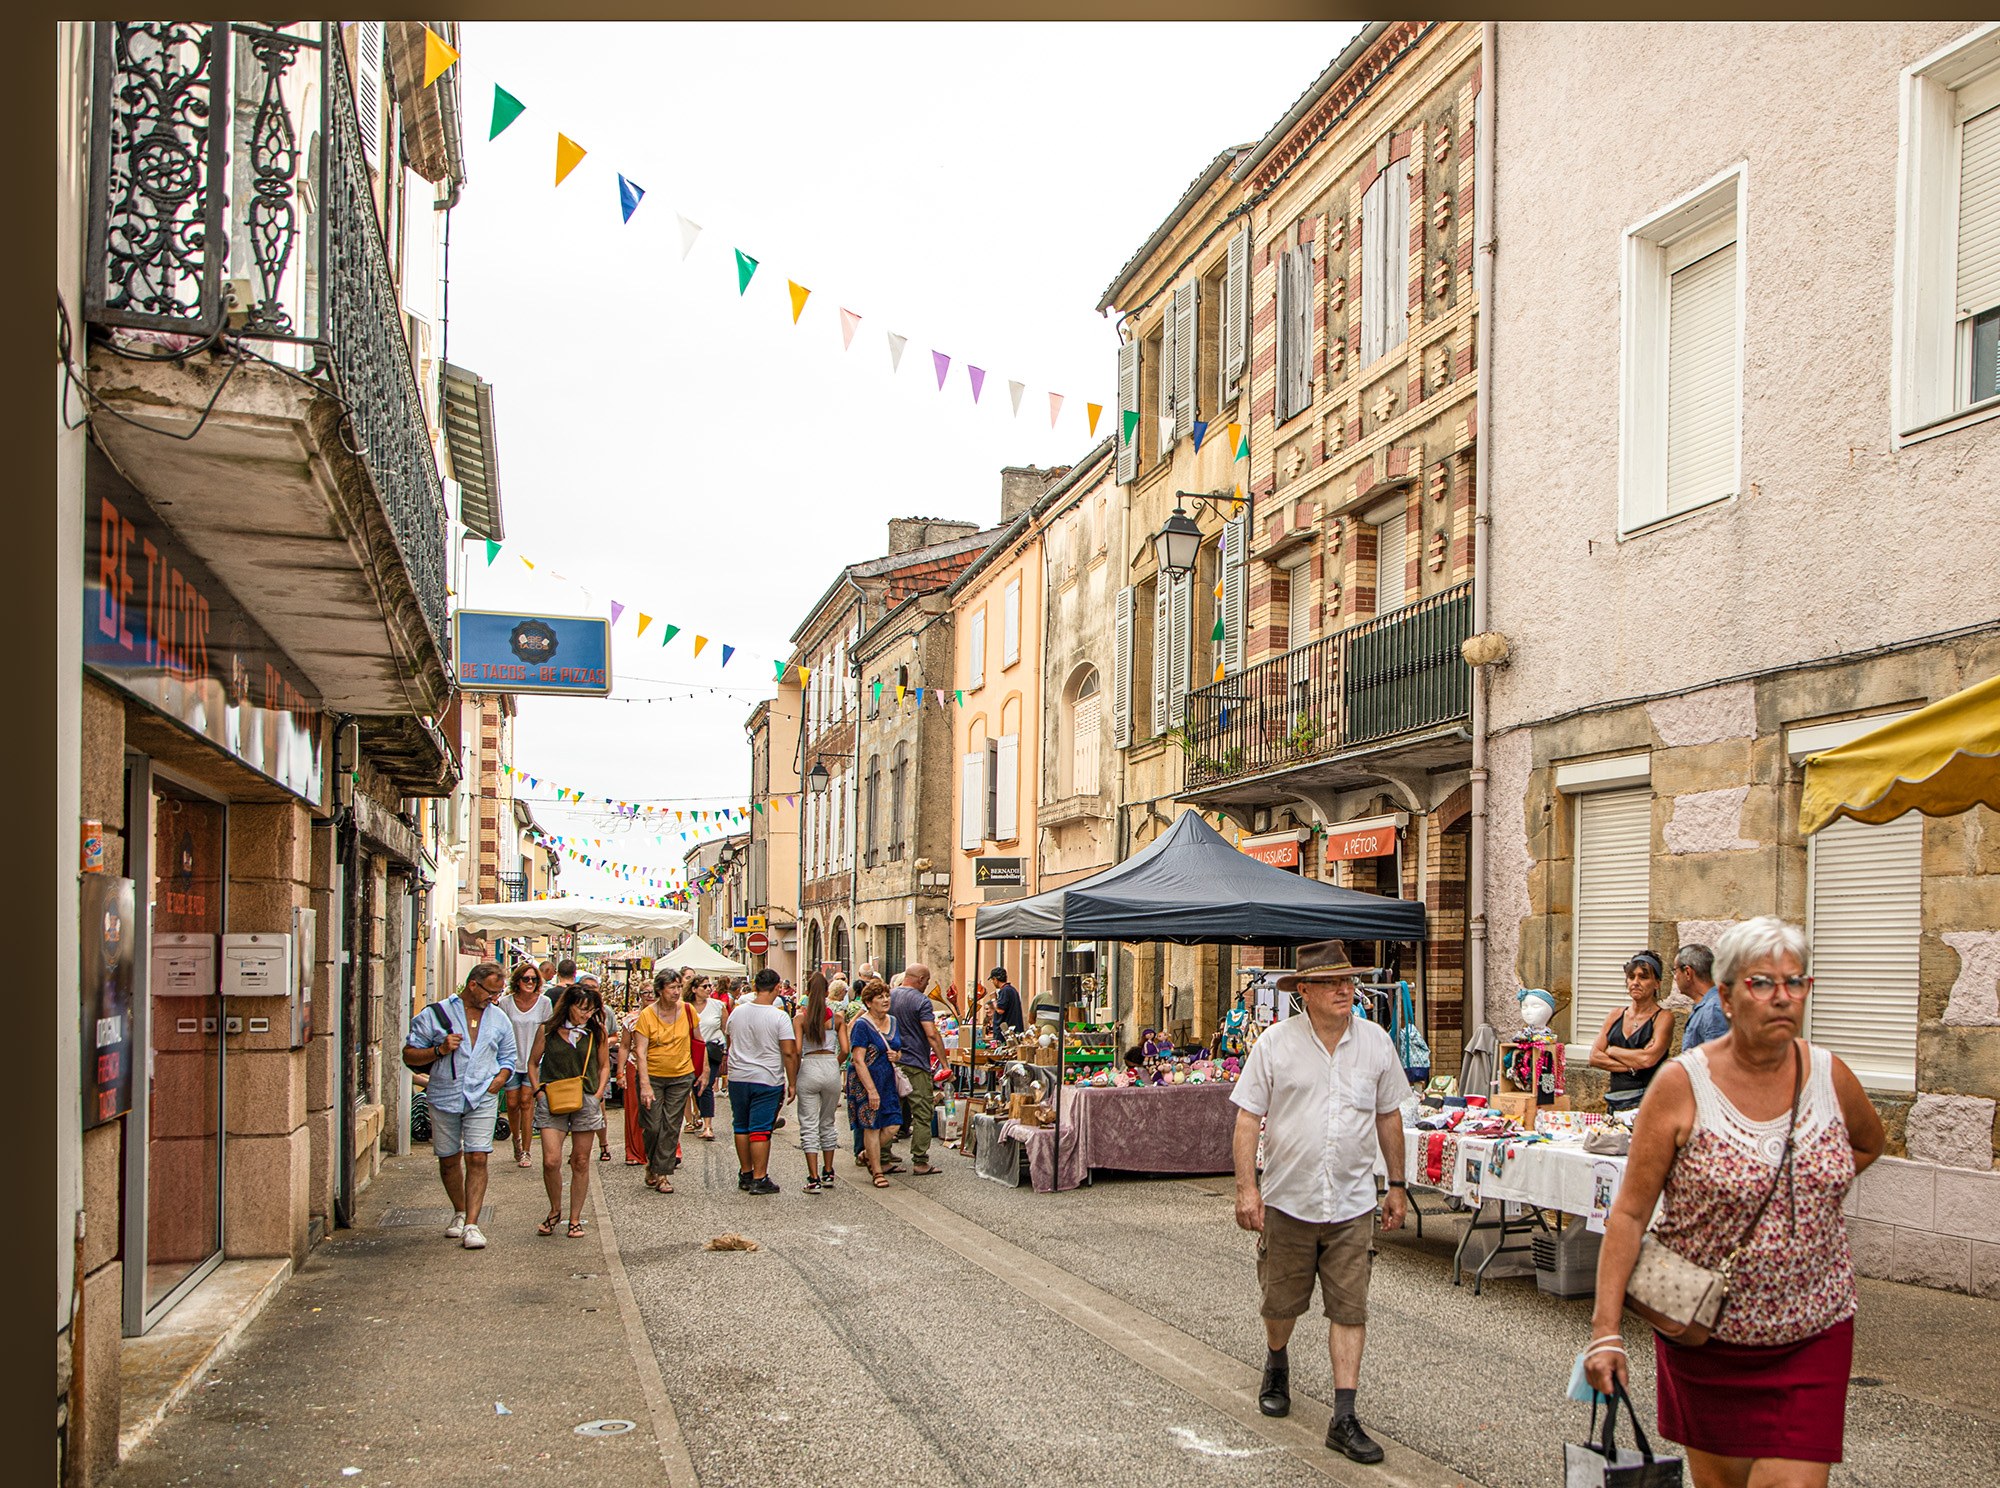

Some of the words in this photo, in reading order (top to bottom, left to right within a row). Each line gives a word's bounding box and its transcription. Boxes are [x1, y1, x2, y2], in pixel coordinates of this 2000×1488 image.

[99, 496, 135, 651] BE
[144, 537, 211, 702] TACOS
[461, 662, 478, 678] BE
[481, 663, 526, 680] TACOS
[540, 666, 557, 682] BE
[560, 668, 605, 684] PIZZAS
[1343, 841, 1349, 855] A
[1350, 833, 1378, 855] PÉTOR
